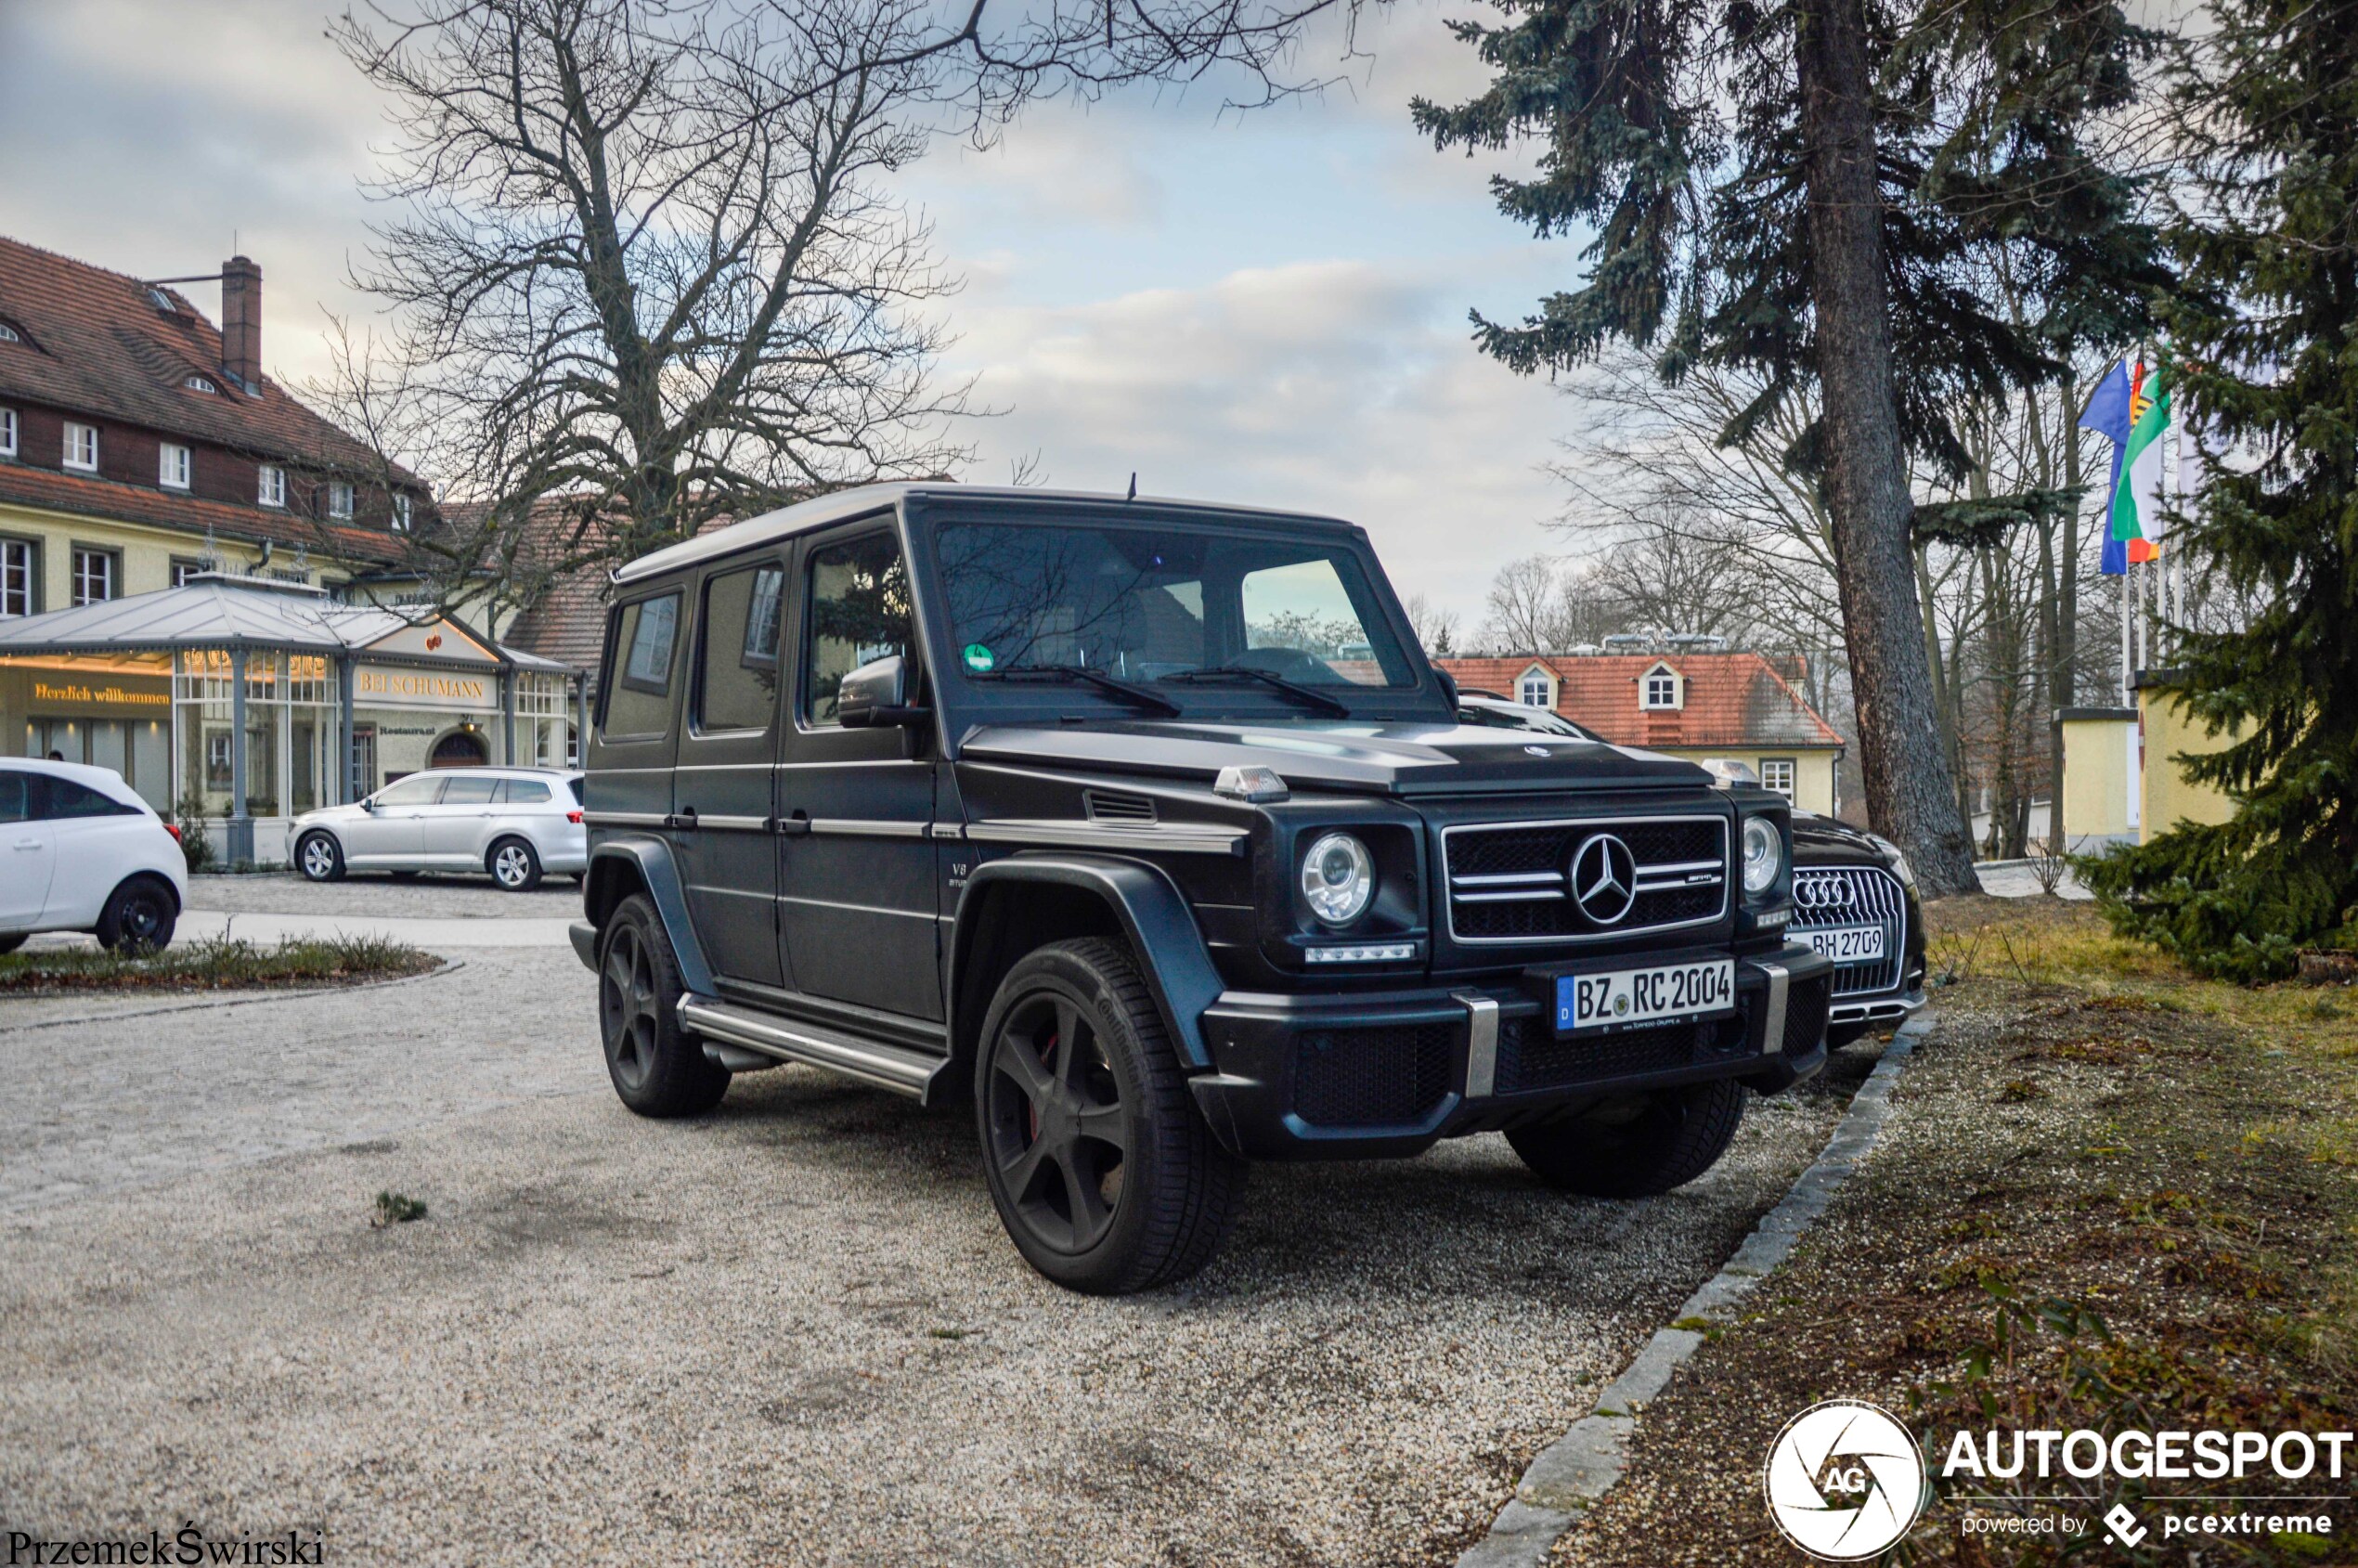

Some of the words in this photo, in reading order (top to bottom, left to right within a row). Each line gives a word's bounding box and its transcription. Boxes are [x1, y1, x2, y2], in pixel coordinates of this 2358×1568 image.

[973, 644, 983, 657] 4
[34, 683, 91, 702] Herzlich
[94, 687, 170, 706] willkommen
[359, 673, 387, 693] BEI
[392, 676, 484, 698] SCHUMANN
[379, 726, 436, 736] Restaurant
[952, 863, 966, 875] V8
[1813, 934, 1836, 957] BH
[1841, 930, 1882, 956] 2709
[1561, 1008, 1569, 1020] D
[1577, 978, 1612, 1020] BZ
[1633, 972, 1666, 1013] RC
[1671, 965, 1730, 1009] 2004
